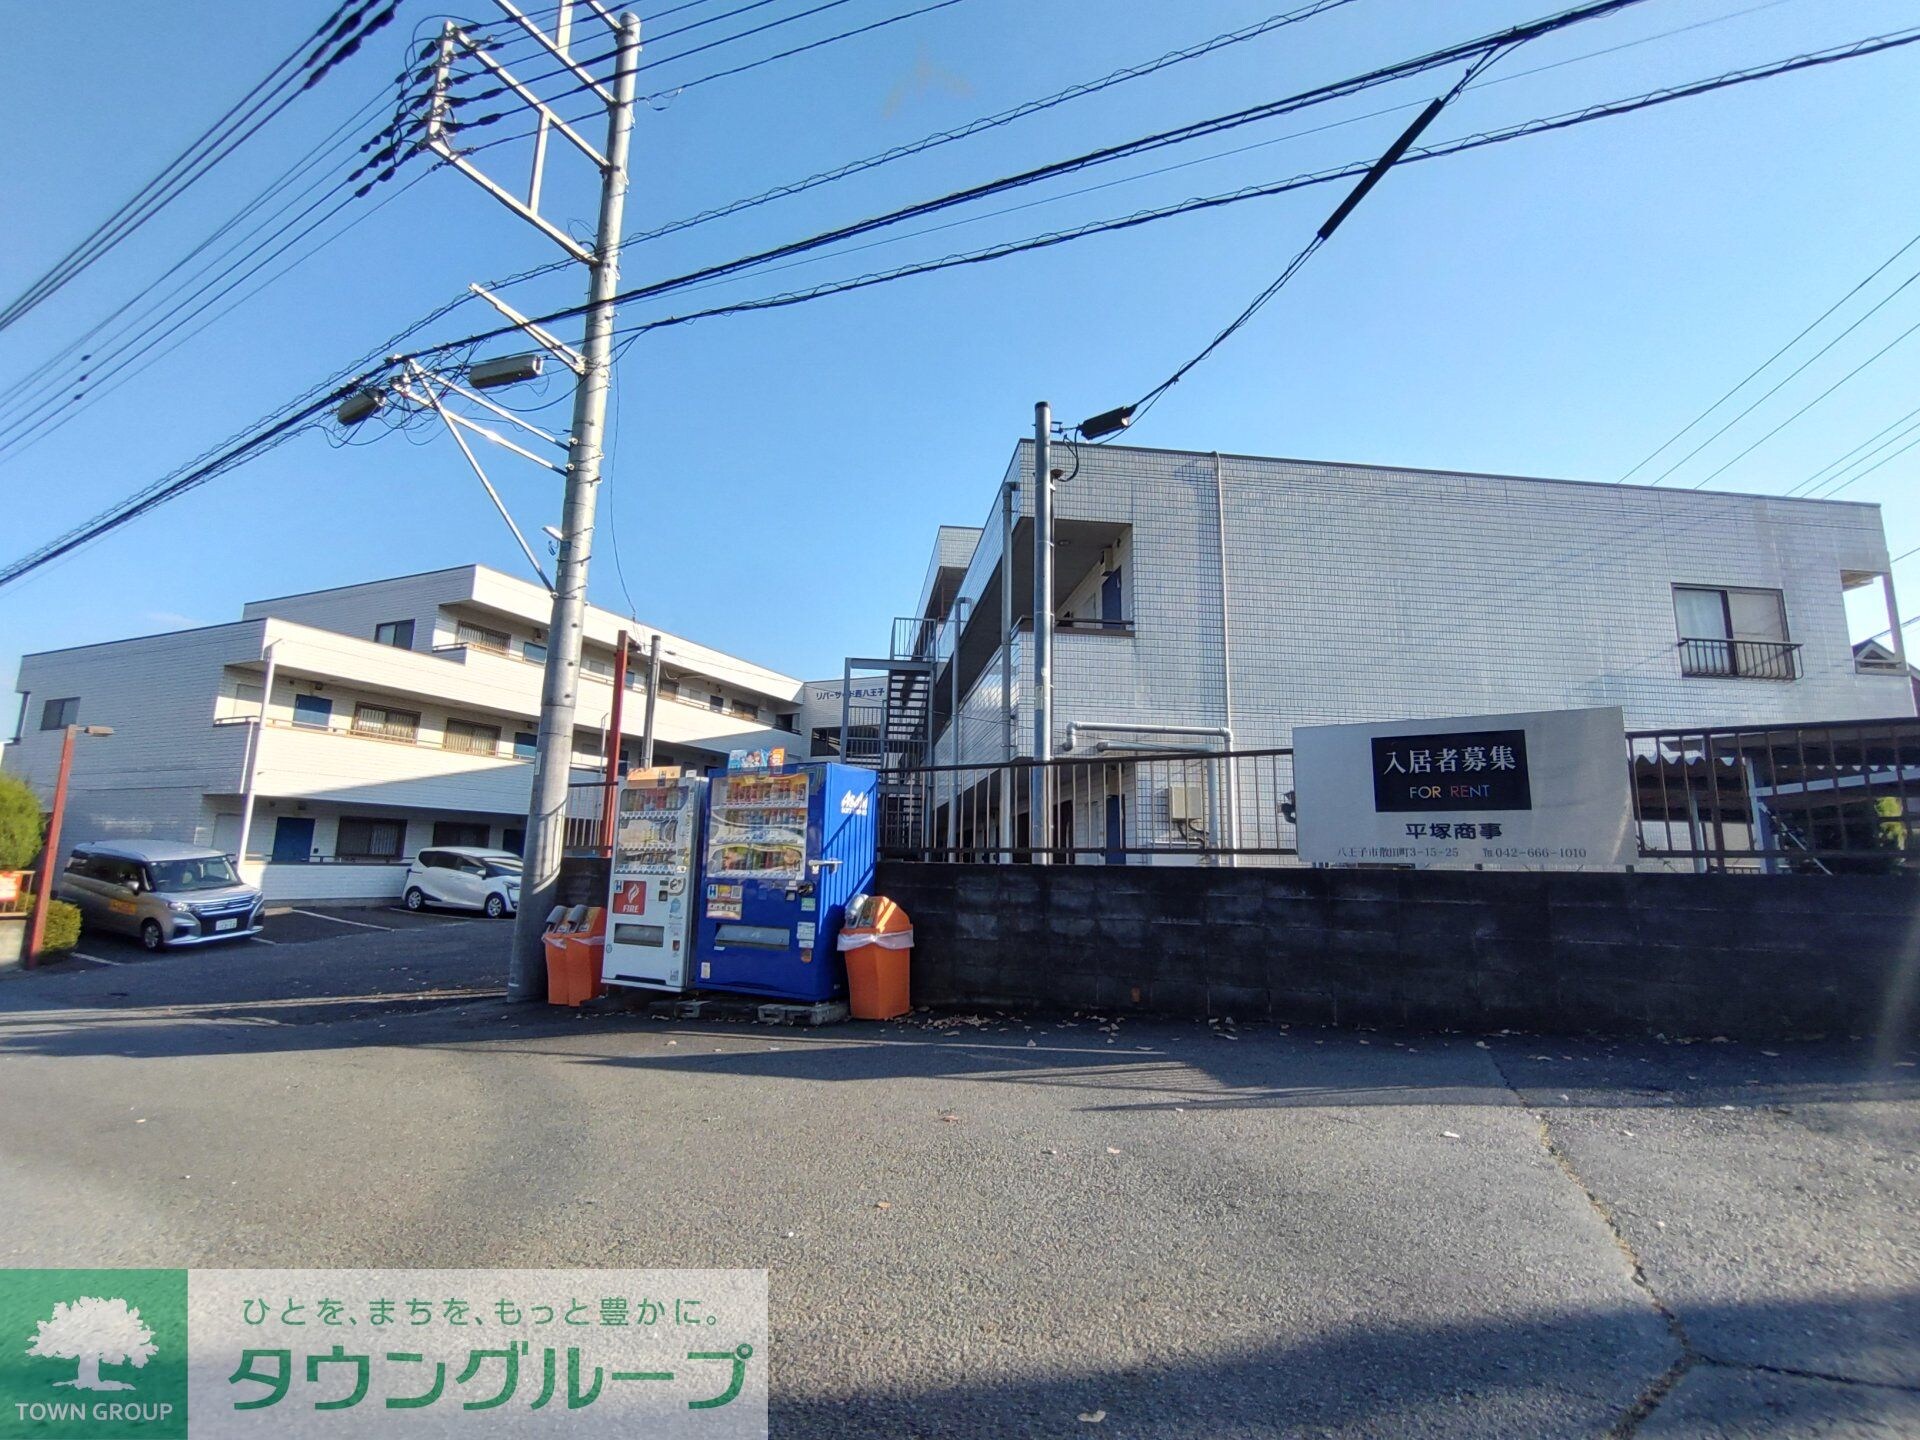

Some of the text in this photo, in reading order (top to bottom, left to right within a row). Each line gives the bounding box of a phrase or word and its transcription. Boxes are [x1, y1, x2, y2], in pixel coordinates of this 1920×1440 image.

[816, 687, 885, 700] リバーサド西八王子
[1383, 745, 1516, 775] 入居者募集
[1409, 784, 1491, 799] FOR RENT
[1405, 822, 1503, 840] 平塚商事
[622, 904, 639, 913] FIRE
